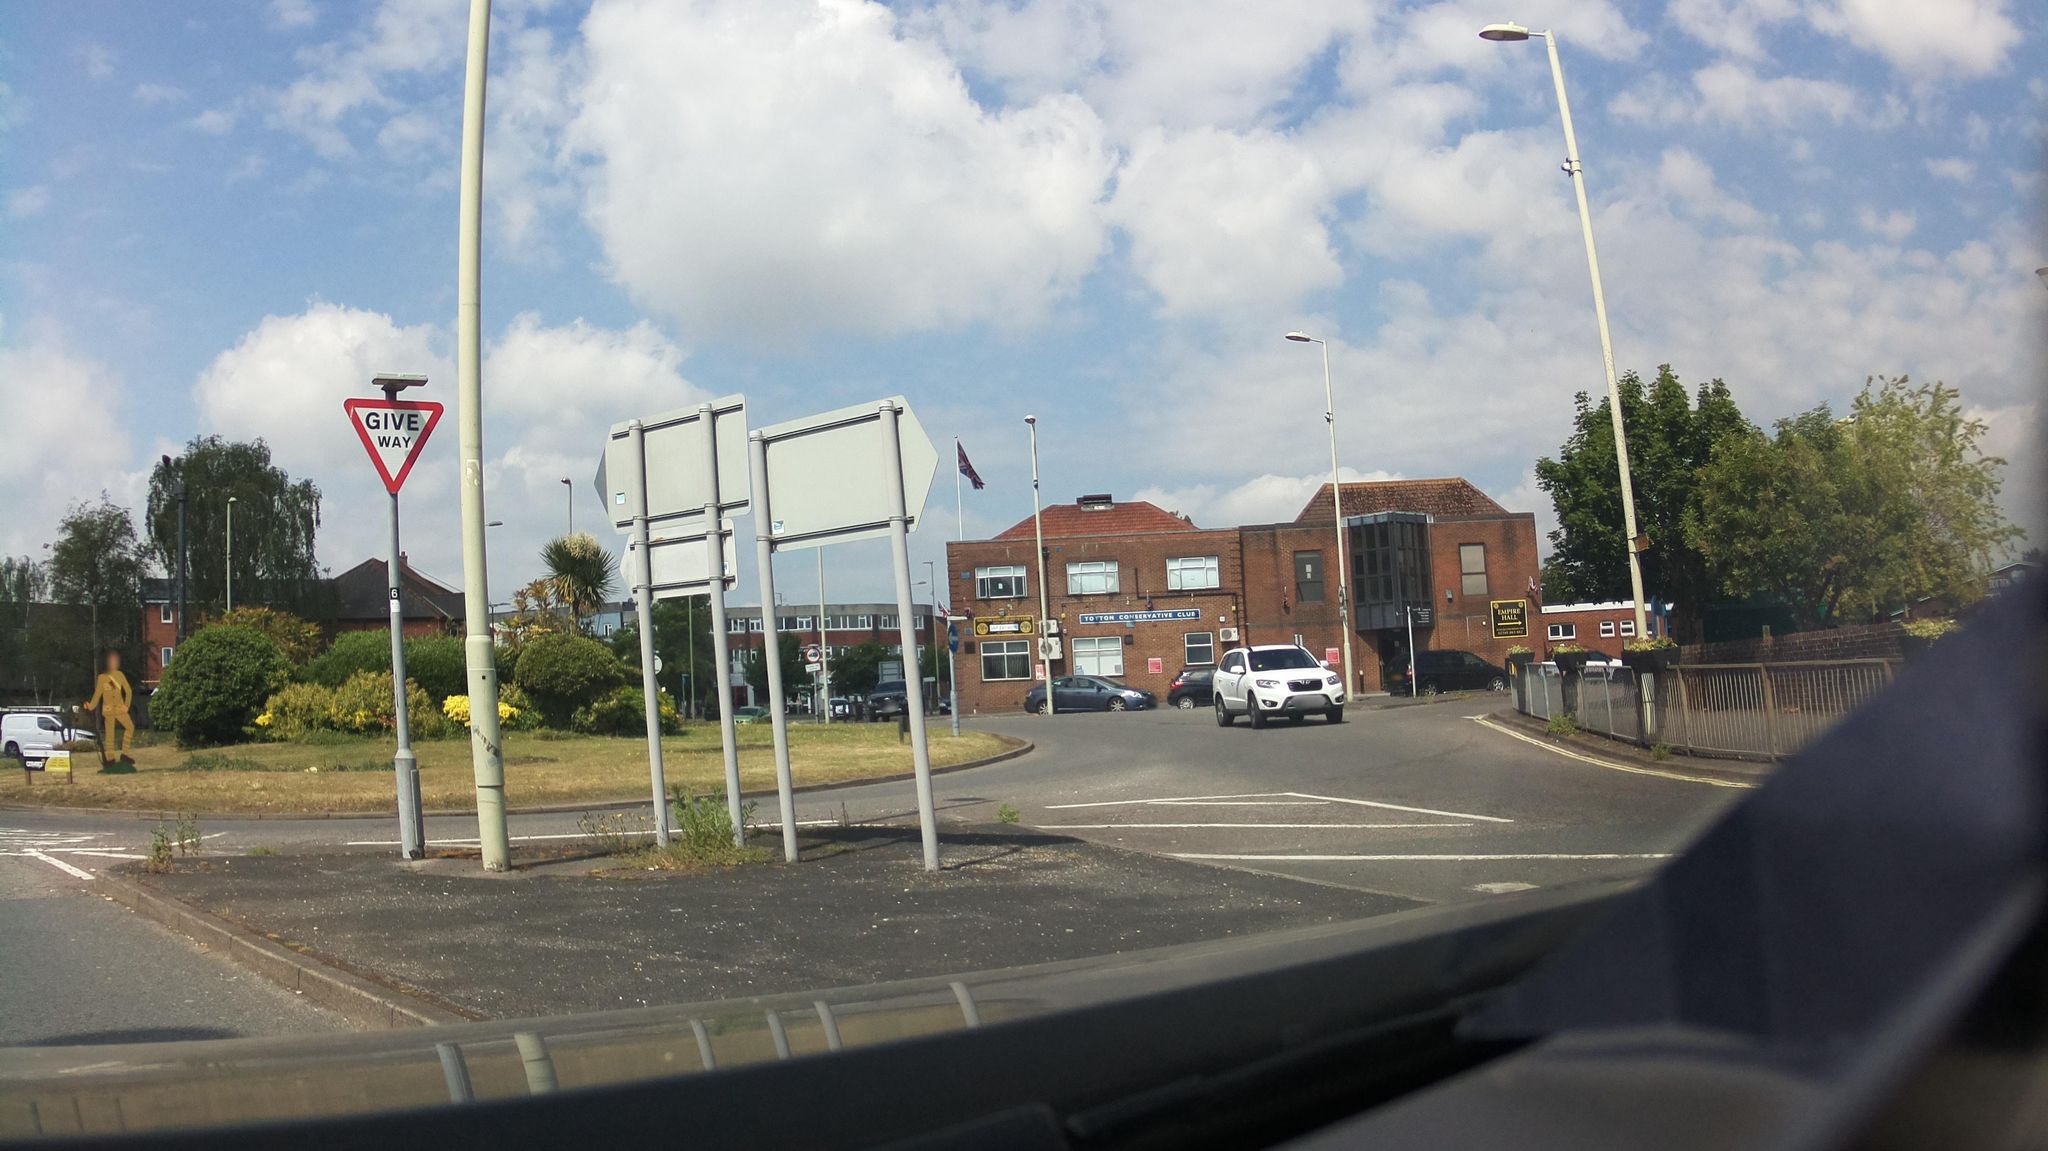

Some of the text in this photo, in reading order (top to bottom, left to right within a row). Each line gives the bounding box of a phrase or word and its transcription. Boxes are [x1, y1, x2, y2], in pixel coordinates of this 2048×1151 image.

[365, 412, 419, 431] GIVE
[378, 436, 411, 448] WAY
[391, 588, 398, 598] 6
[1118, 611, 1173, 621] CONSERVATIVE
